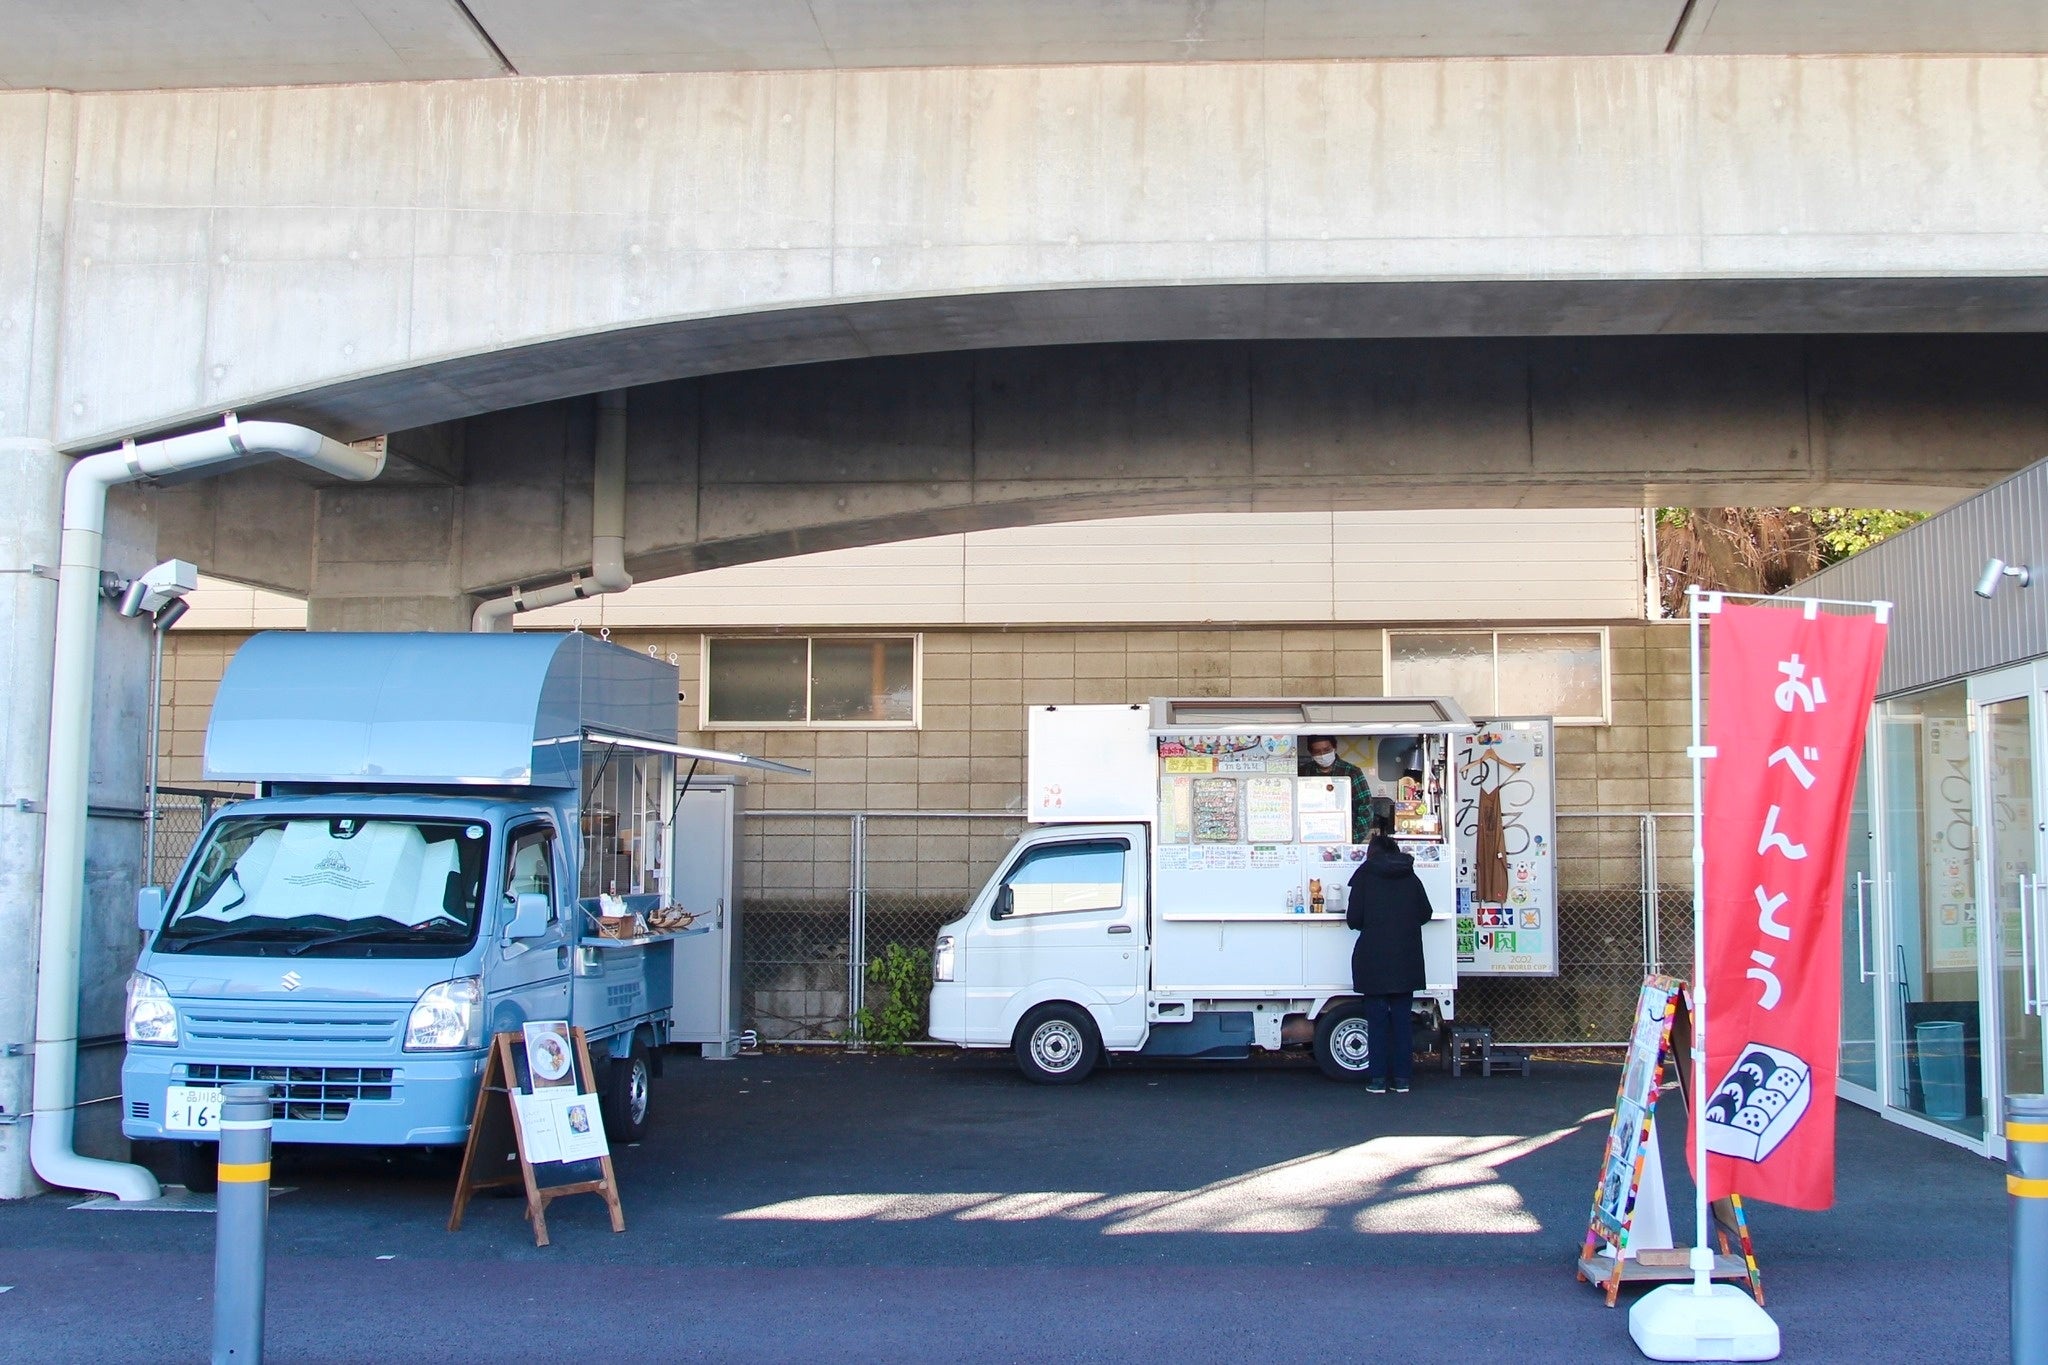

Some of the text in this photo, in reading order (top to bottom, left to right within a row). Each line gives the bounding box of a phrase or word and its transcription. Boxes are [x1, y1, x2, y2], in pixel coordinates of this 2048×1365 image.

[1746, 653, 1828, 1011] おべんとう
